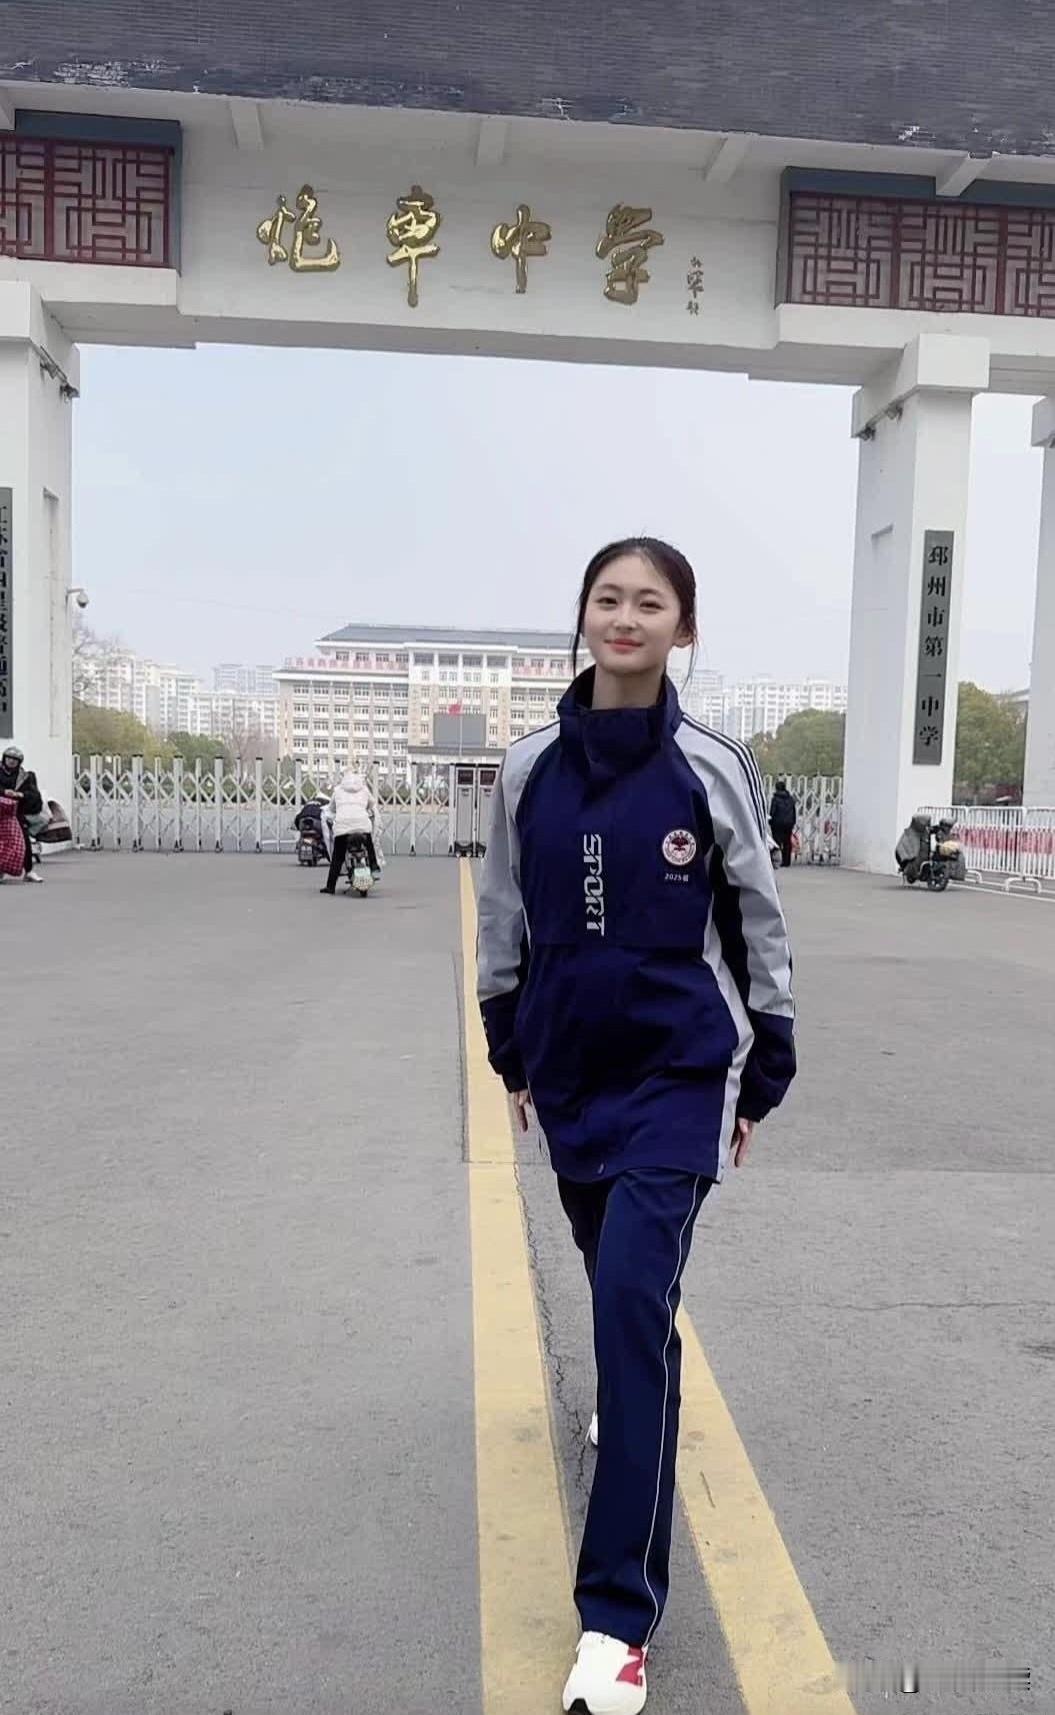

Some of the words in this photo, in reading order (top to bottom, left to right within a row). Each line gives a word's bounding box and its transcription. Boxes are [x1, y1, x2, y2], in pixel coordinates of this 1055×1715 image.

[918, 545, 949, 745] 邳州市第一中学
[583, 833, 606, 937] SPORT
